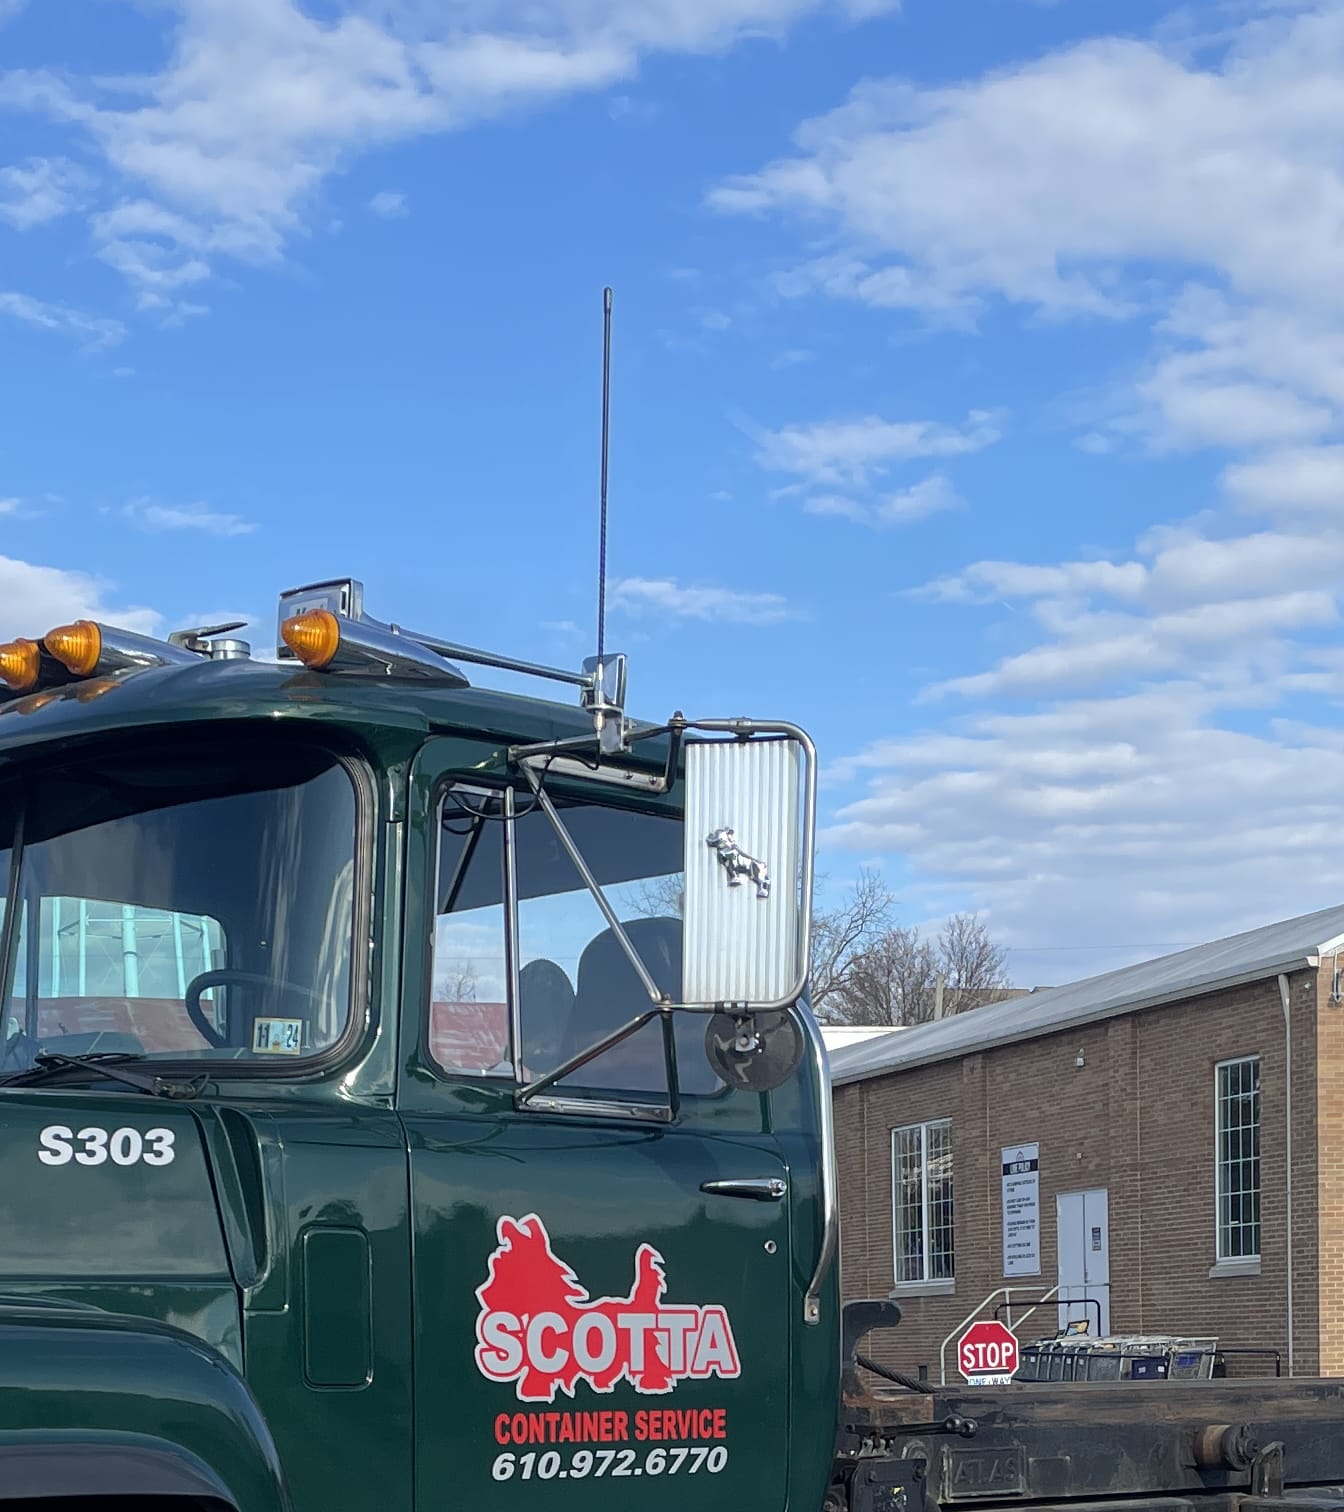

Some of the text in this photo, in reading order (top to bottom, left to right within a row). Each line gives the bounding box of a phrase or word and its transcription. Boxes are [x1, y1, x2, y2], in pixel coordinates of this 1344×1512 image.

[286, 1023, 299, 1049] 24
[37, 1125, 175, 1166] S303
[480, 1310, 737, 1375] SCOTTA
[962, 1342, 1014, 1369] STOP
[494, 1408, 727, 1445] CONTAINER SERVICE
[491, 1446, 728, 1481] 610.972.6770
